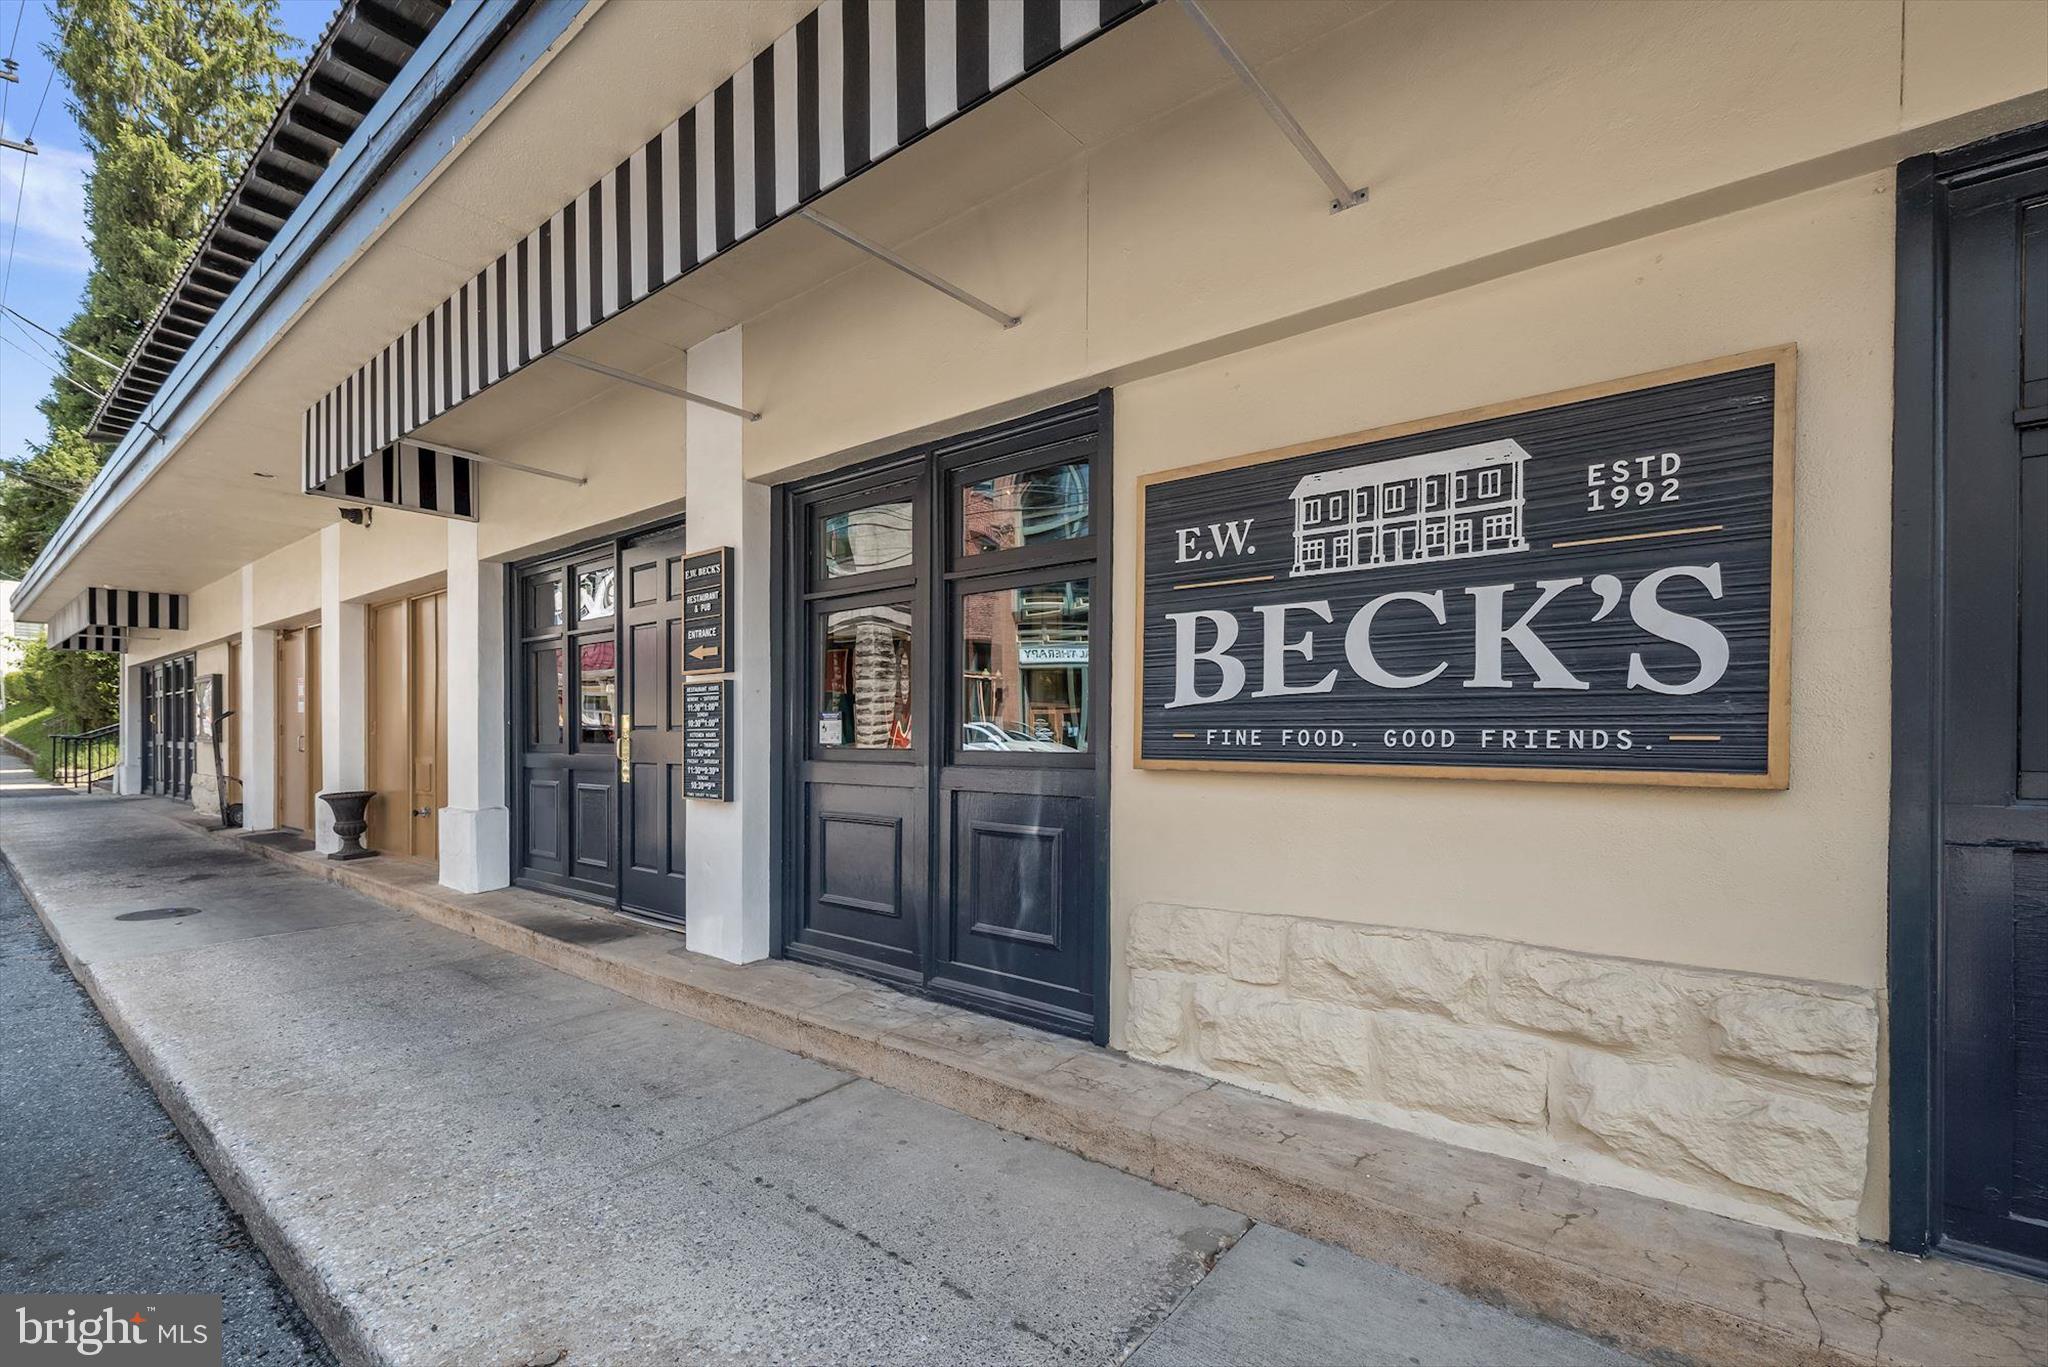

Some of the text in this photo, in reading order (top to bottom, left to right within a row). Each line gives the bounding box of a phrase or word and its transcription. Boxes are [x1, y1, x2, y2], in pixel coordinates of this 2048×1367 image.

[1587, 452, 1682, 488] ESTD
[1587, 478, 1681, 512] 1992
[1175, 519, 1256, 564] E.W.
[686, 591, 719, 604] RESTAURANT
[700, 602, 712, 612] PUB
[687, 627, 717, 640] ENTRANCE
[1164, 561, 1731, 710] BECK'S
[1206, 729, 1655, 752] FINE FOOD. GOOD FRIENDS.
